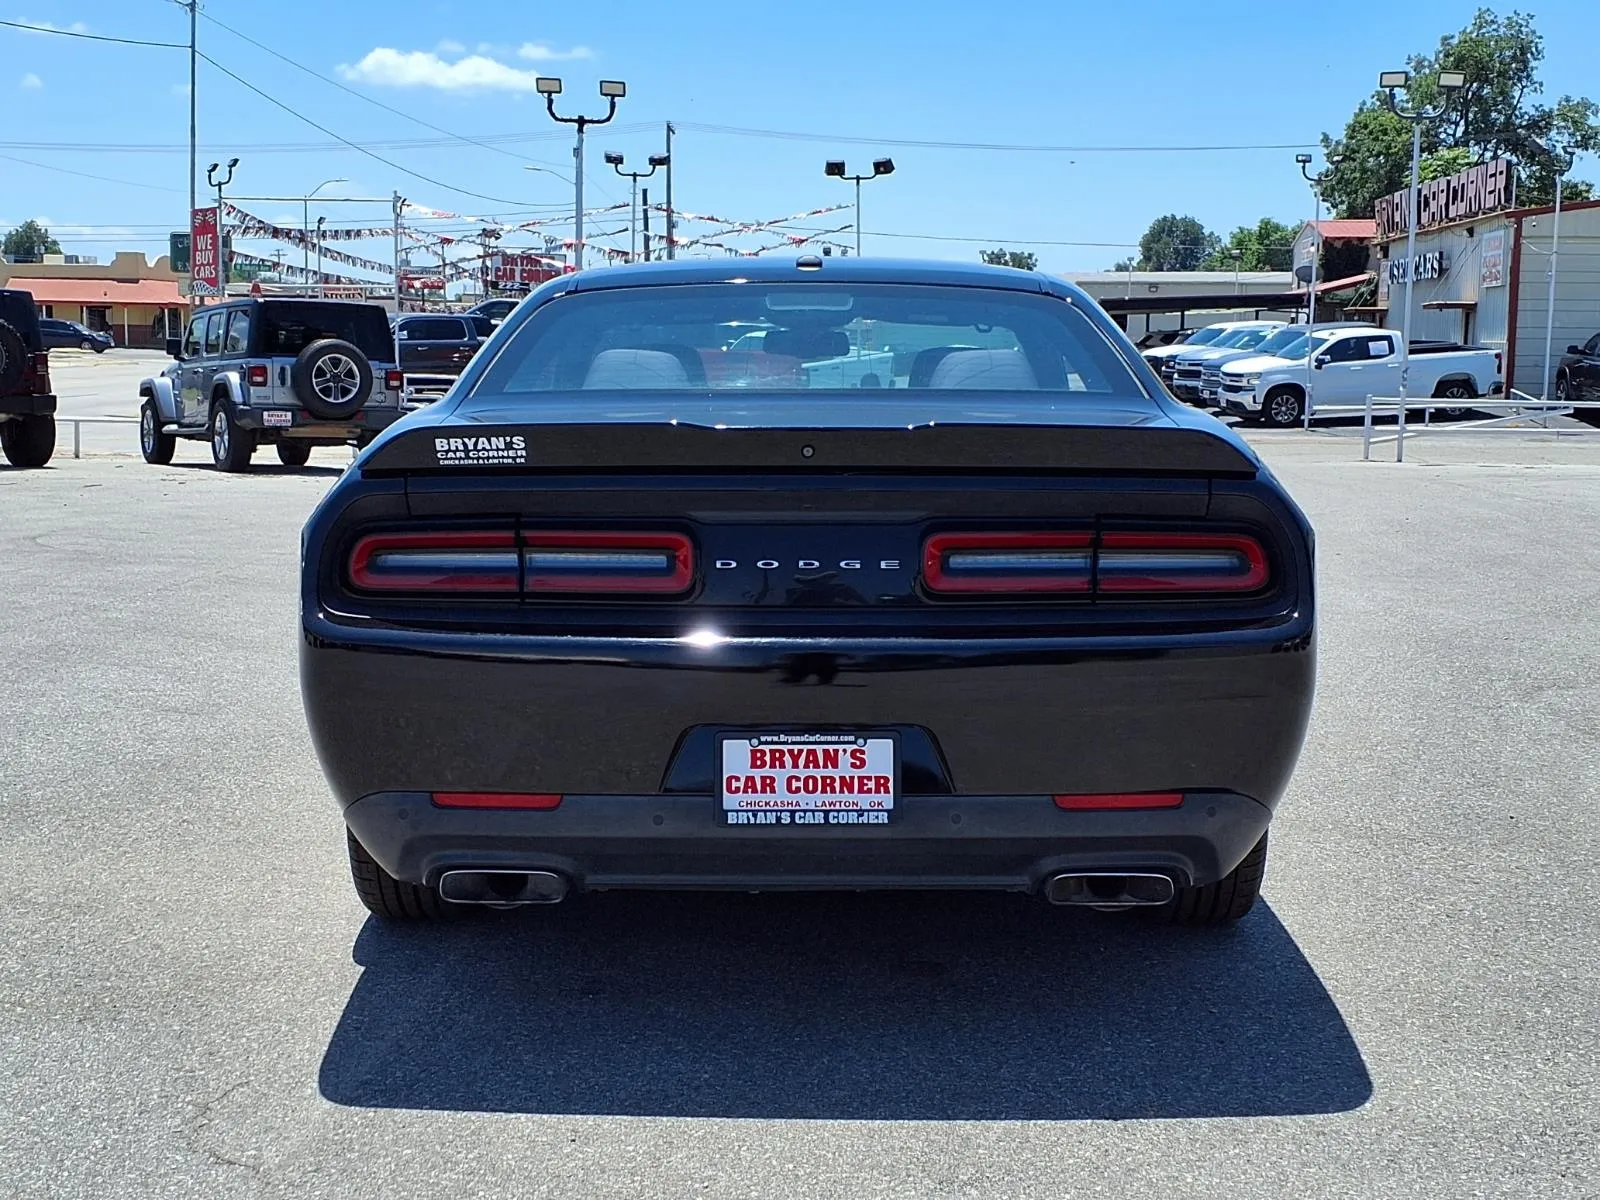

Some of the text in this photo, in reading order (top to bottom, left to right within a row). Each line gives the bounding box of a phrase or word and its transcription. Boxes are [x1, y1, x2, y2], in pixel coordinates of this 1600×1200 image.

[1420, 177, 1448, 225] CAR
[1449, 159, 1507, 218] CORNER
[196, 233, 213, 250] WE
[195, 250, 214, 265] BUY
[194, 265, 216, 279] CARS
[1412, 251, 1440, 281] CARS
[494, 267, 516, 281] CAR
[323, 291, 363, 299] KITCHEN
[434, 436, 526, 451] BRYAN'S
[468, 450, 527, 458] CORNER
[715, 560, 900, 569] DODGE
[749, 748, 867, 770] BRYAN'S
[725, 775, 891, 795] CAR CORNER
[738, 800, 885, 809] CHICKASHA LAWTON, OK
[727, 811, 791, 824] BRYAN'S
[795, 811, 825, 824] CAR
